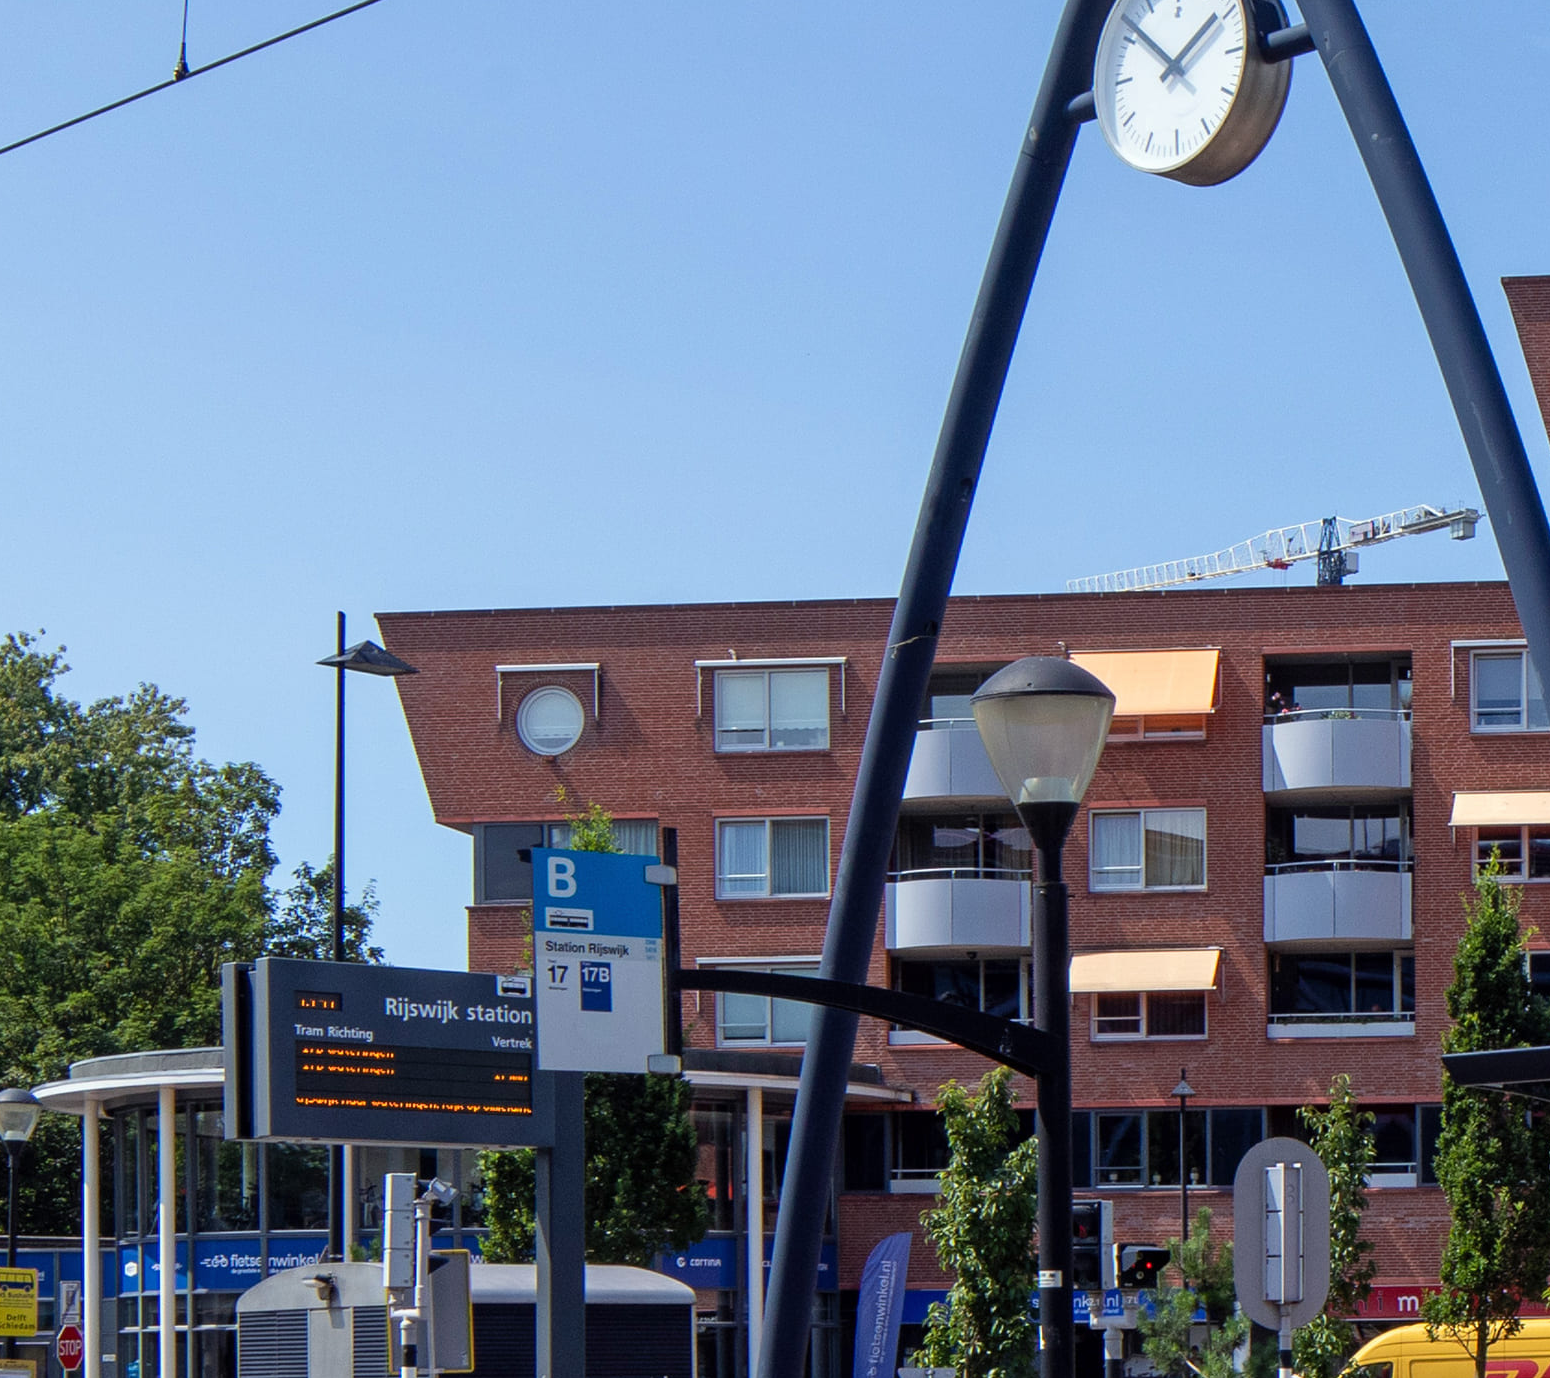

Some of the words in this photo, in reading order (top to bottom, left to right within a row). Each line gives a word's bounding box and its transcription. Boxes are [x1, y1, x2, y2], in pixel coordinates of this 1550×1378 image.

[547, 856, 577, 898] B
[545, 940, 585, 953] Station
[588, 942, 630, 957] Rijswijk
[547, 965, 569, 983] 17
[581, 966, 610, 983] 17B
[385, 997, 460, 1024] Rijswijk
[466, 1003, 533, 1024] station
[294, 1024, 324, 1037] Tram
[327, 1026, 374, 1042] Richting
[491, 1036, 533, 1049] Vertrek
[6, 1313, 27, 1322] Delft
[59, 1339, 82, 1356] STOP
